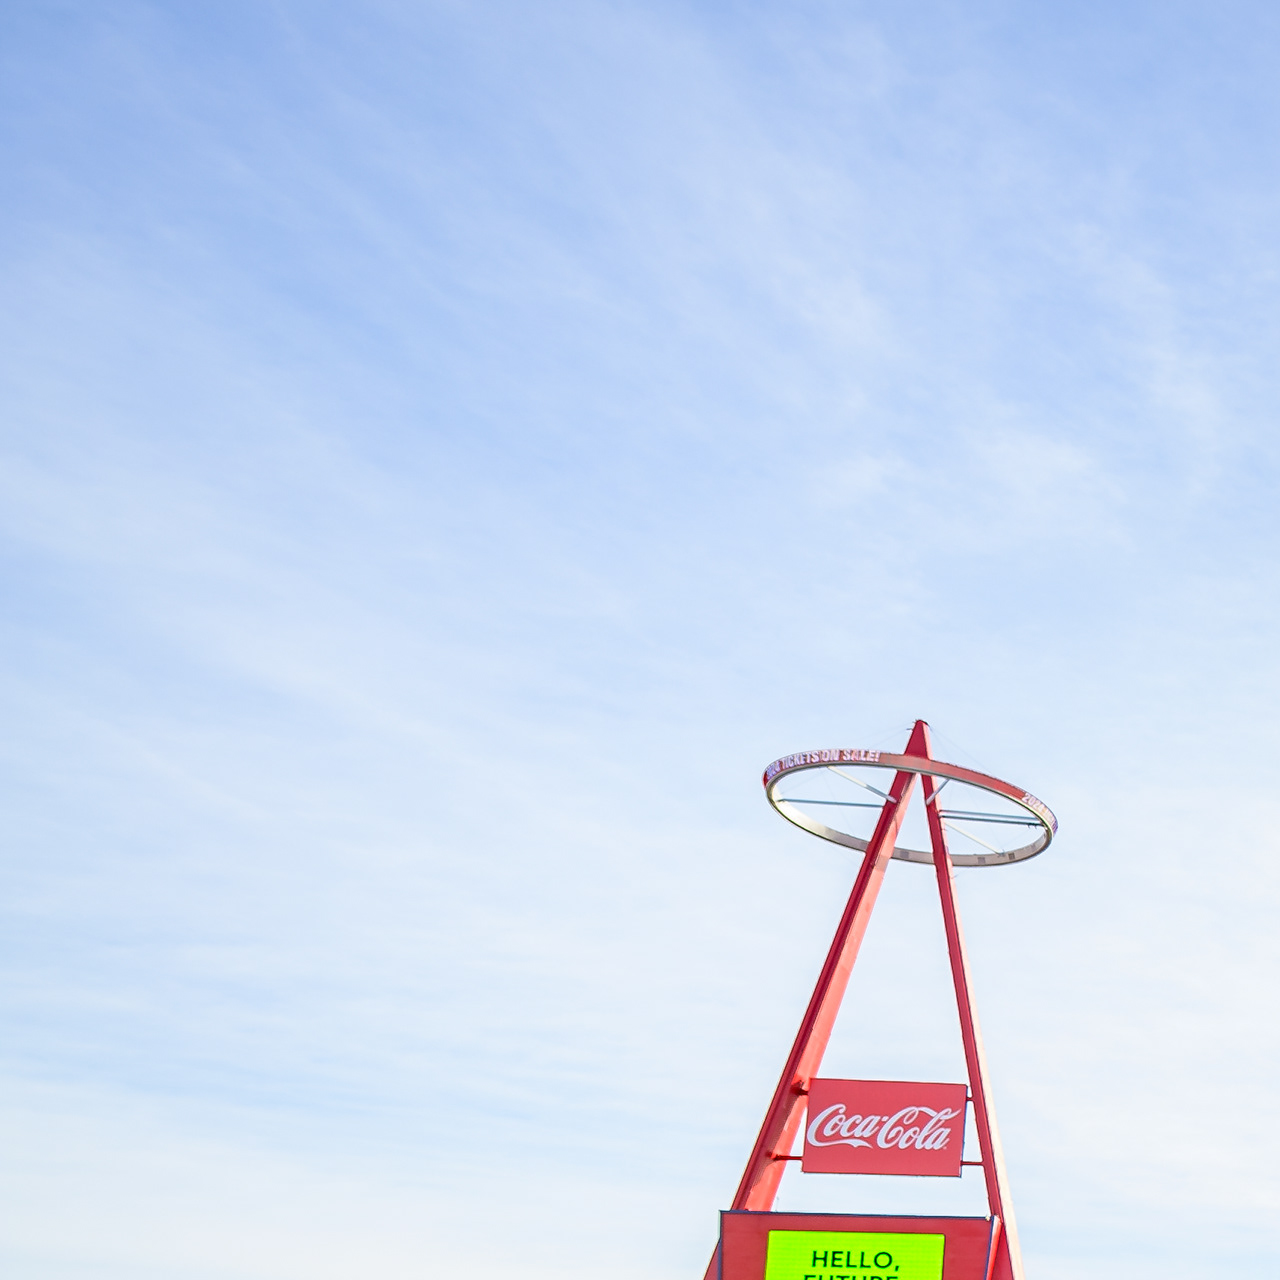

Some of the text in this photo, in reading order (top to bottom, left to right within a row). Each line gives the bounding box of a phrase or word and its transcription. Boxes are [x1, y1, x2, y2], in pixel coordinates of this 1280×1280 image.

[781, 750, 820, 770] TICKETS
[820, 748, 840, 762] ON
[842, 748, 881, 763] SALE!
[806, 1103, 963, 1151] Coca-Cola
[811, 1250, 900, 1272] HELLO,
